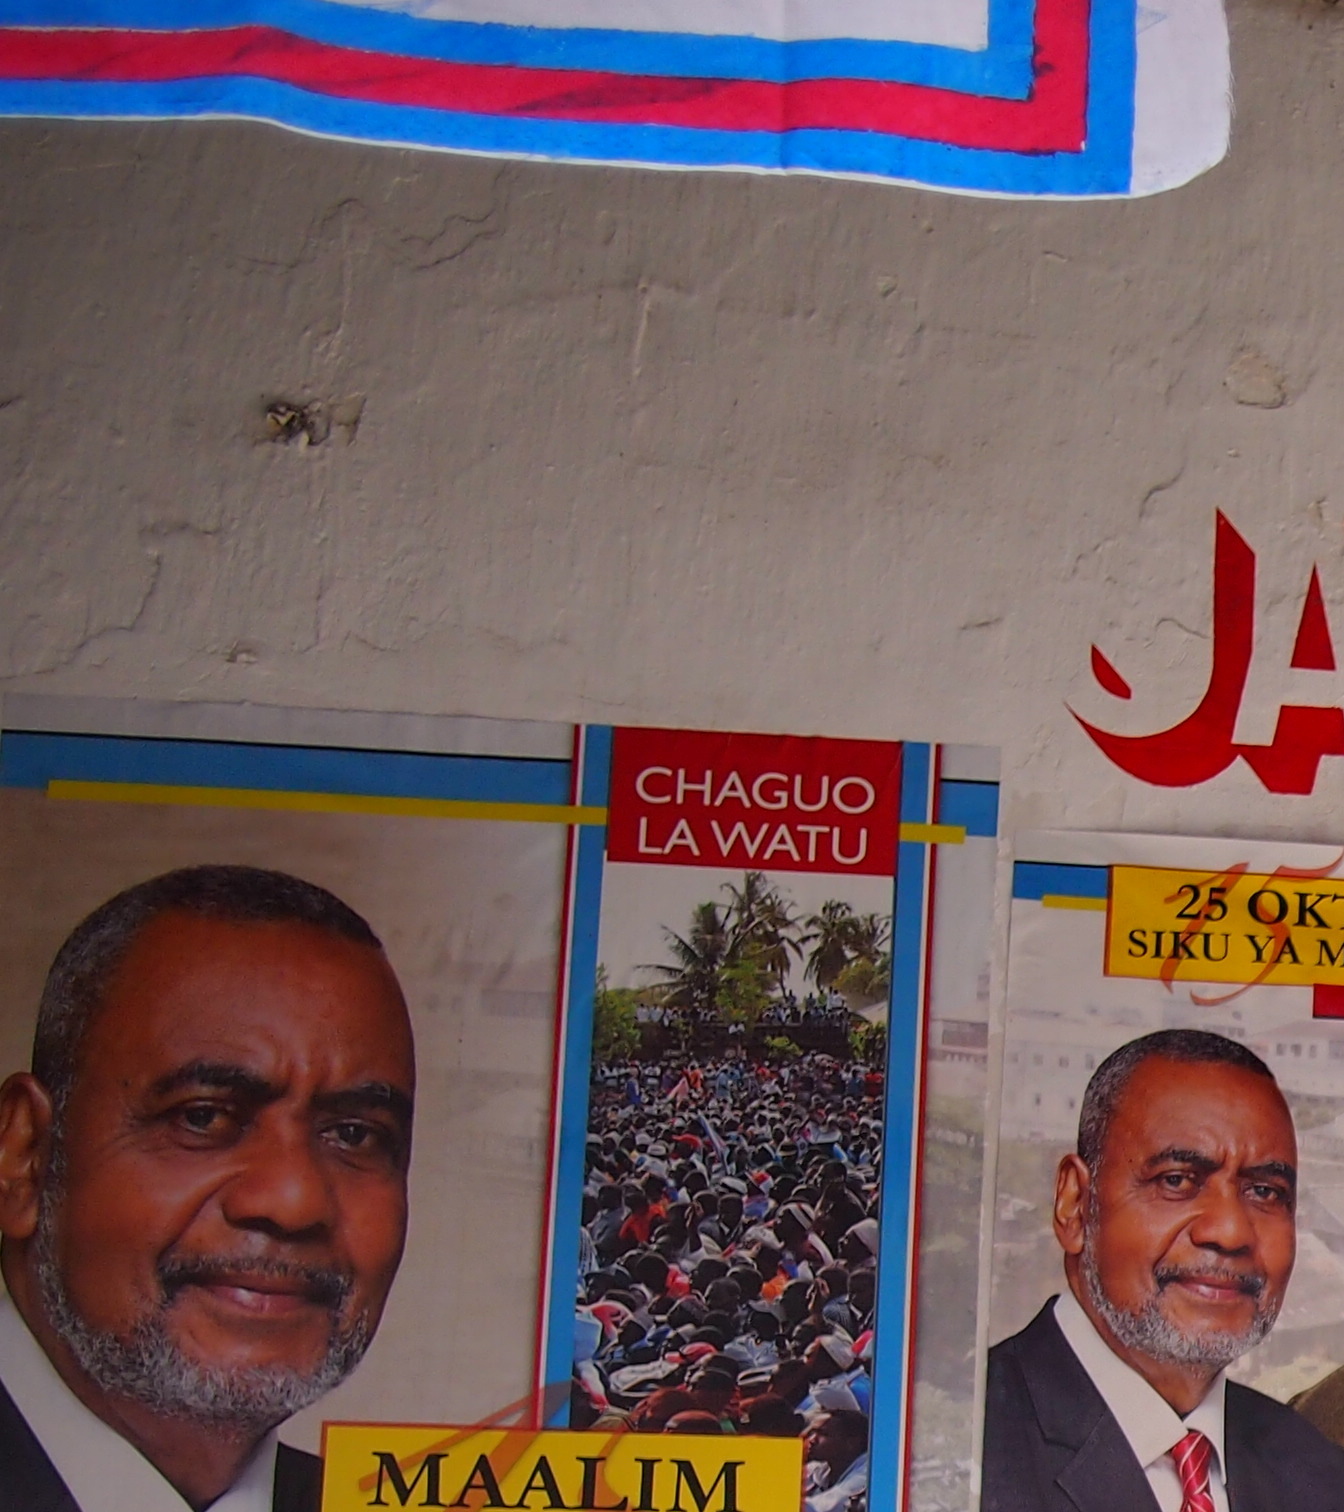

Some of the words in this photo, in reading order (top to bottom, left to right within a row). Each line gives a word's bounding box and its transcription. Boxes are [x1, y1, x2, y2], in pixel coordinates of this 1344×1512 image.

[635, 766, 876, 814] CHAGUO
[637, 816, 700, 856] LA
[710, 819, 868, 865] WATU
[1175, 884, 1228, 921] 25
[1127, 929, 1230, 962] SIKU
[1245, 935, 1302, 966] YA
